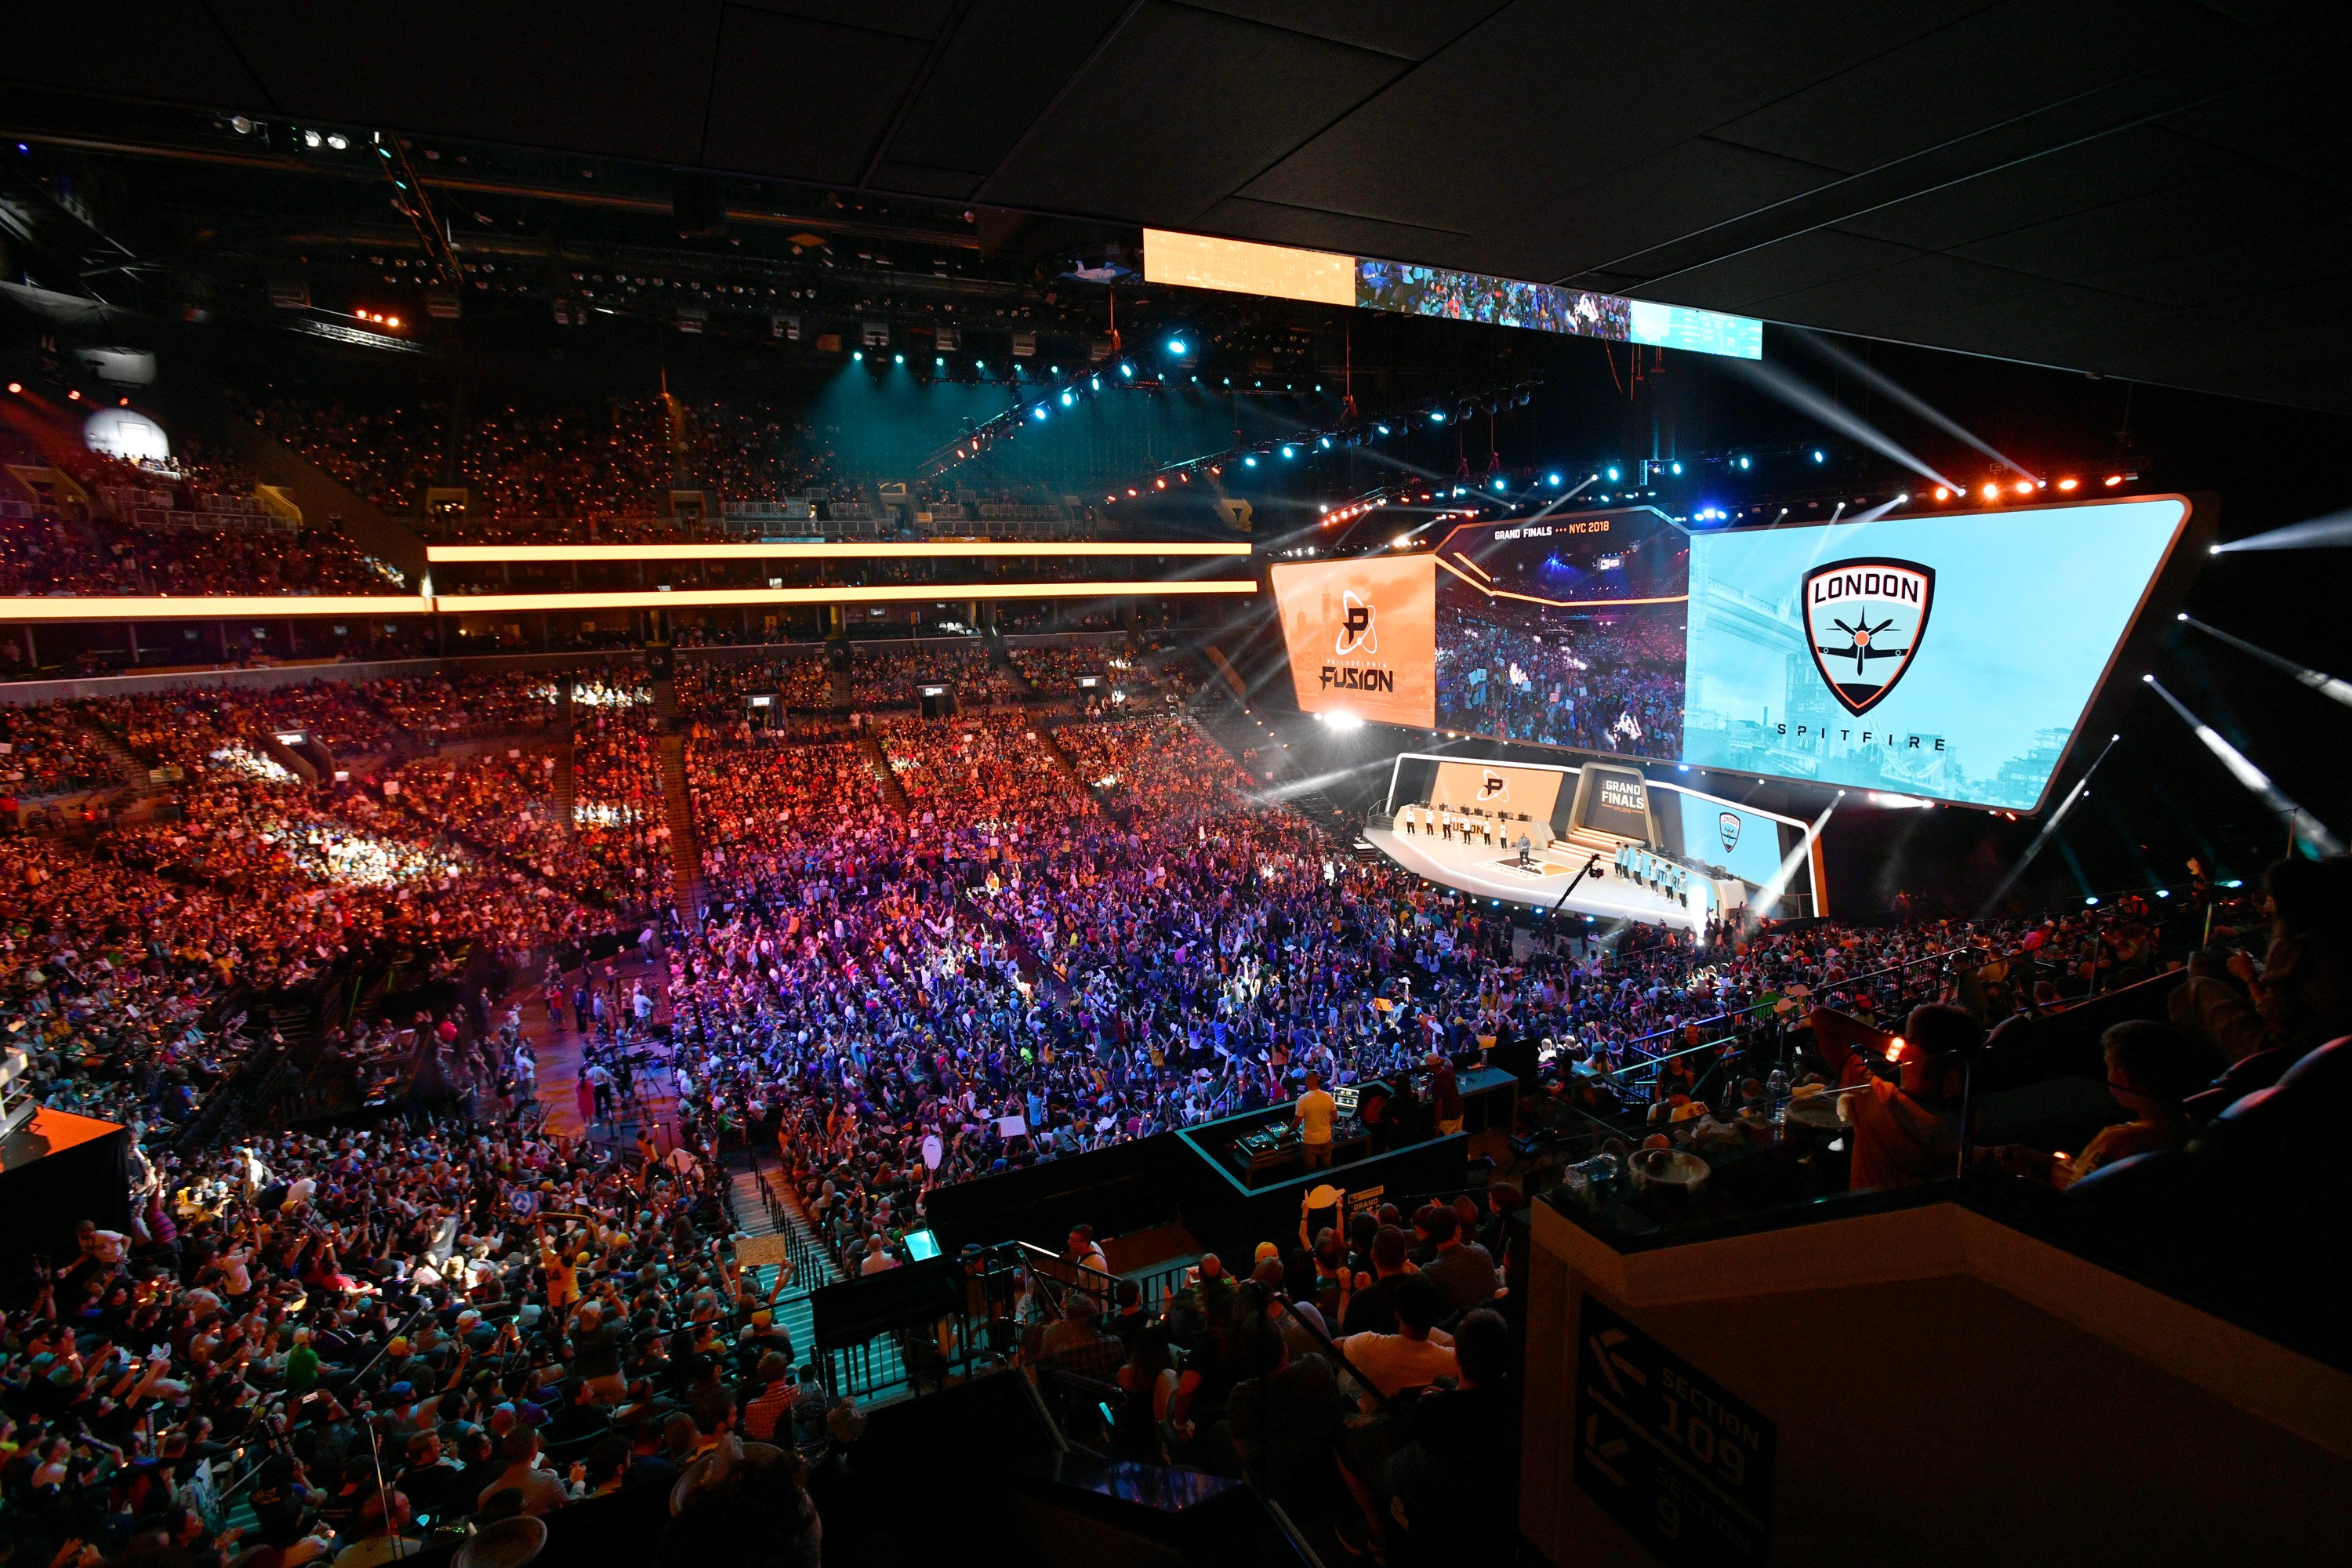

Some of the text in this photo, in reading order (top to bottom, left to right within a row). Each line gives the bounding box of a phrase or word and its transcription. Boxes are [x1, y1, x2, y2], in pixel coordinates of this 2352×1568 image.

[1494, 521, 1610, 540] GRAND FINALS NYC 2018
[1814, 573, 1918, 603] LONDON
[1327, 659, 1387, 668] PHILADELPHIA
[1318, 666, 1393, 692] FUSION
[1777, 723, 1946, 751] SPITFIRE
[1606, 780, 1641, 795] GRAND
[1602, 790, 1644, 809] FINALS
[1722, 815, 1739, 827] LONDON
[1353, 1198, 1378, 1210] GRAND
[1661, 1367, 1760, 1453] SECTION
[1660, 1392, 1746, 1486] 109
[1656, 1494, 1682, 1539] 9
